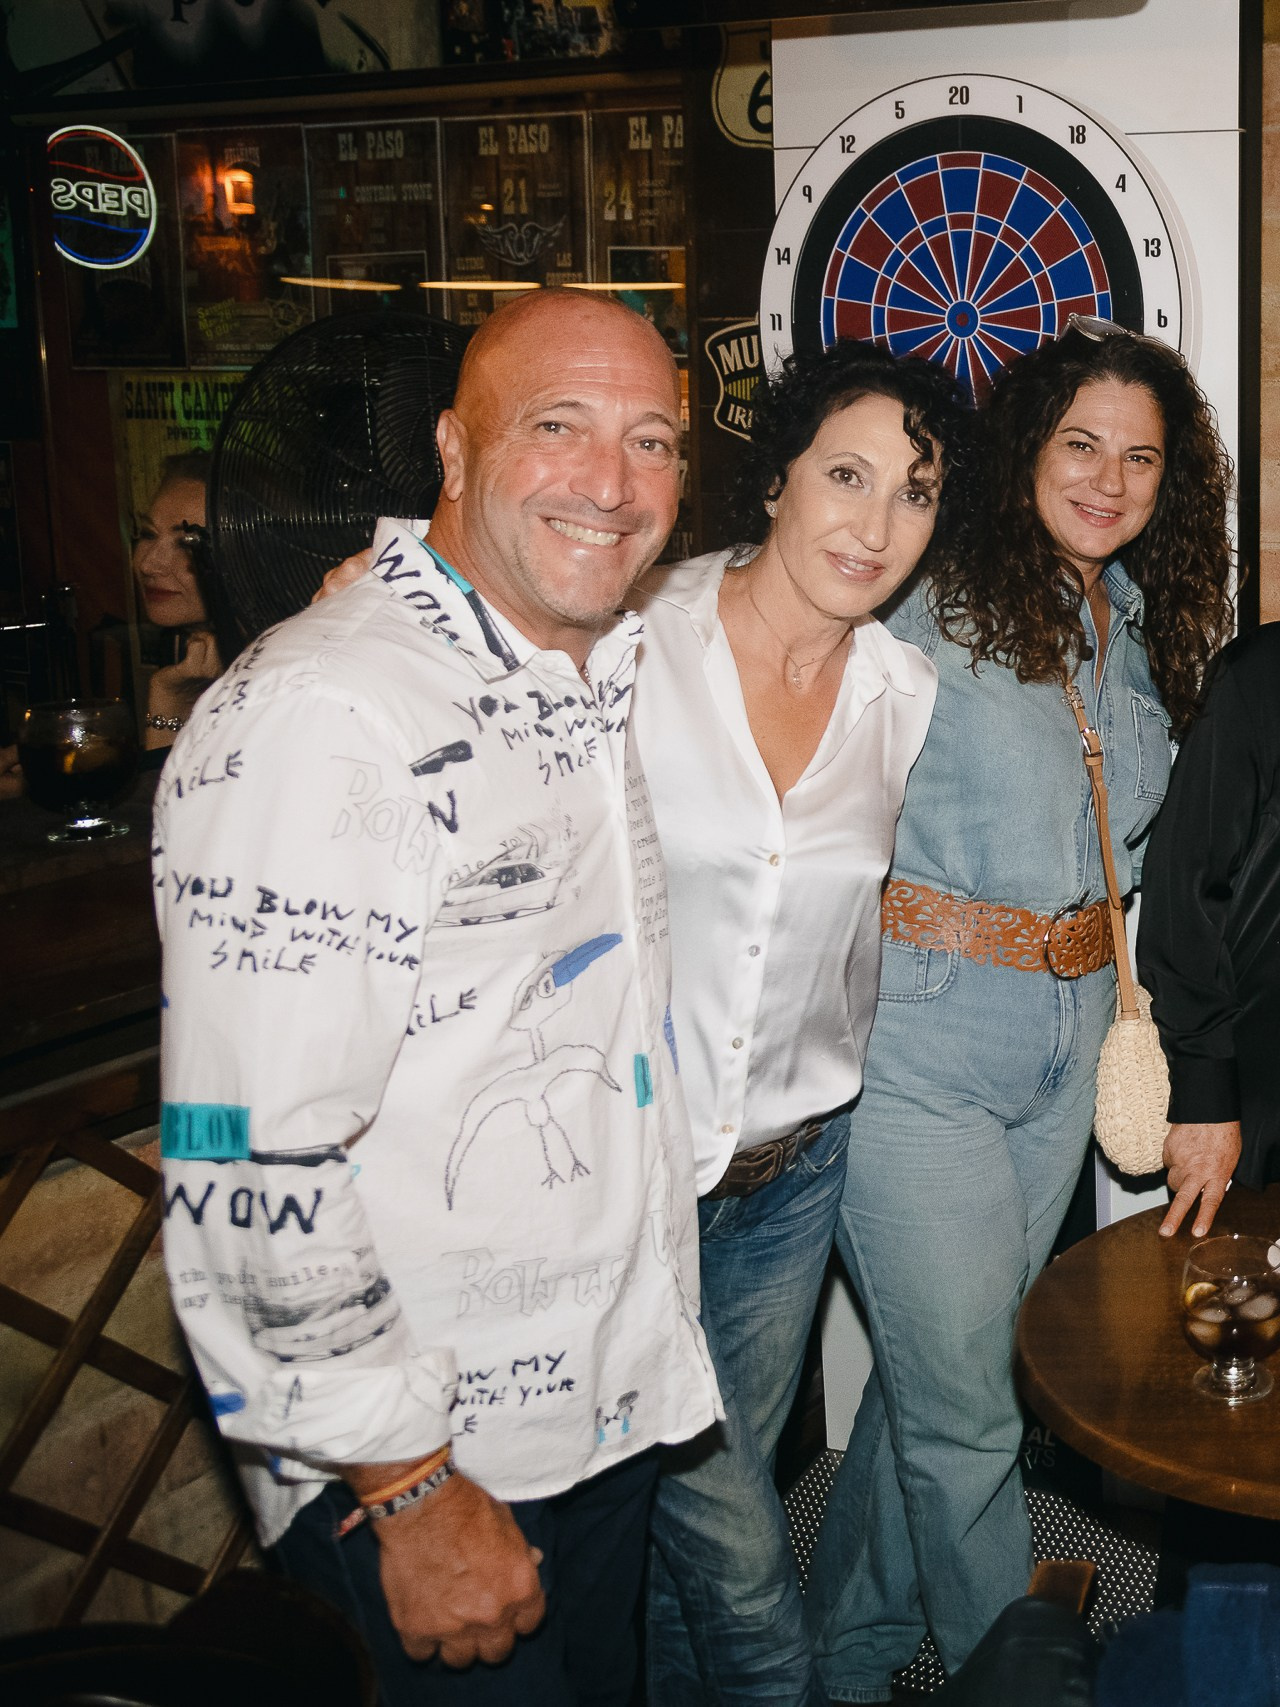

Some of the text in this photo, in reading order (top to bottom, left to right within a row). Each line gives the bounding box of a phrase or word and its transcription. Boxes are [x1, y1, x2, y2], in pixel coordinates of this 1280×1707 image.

[949, 86, 969, 105] 20
[1016, 95, 1023, 113] 1
[895, 101, 905, 119] 5
[338, 129, 404, 161] EL PASO
[478, 123, 550, 156] EL PASO
[628, 116, 652, 150] EL
[839, 136, 856, 153] 12
[1068, 125, 1086, 144] 18
[1116, 174, 1126, 192] 4
[503, 177, 528, 215] 21
[603, 178, 635, 221] 24
[775, 248, 790, 264] 14
[1143, 239, 1161, 257] 13
[770, 313, 782, 330] 11
[125, 381, 176, 419] SANTI
[172, 869, 419, 943] YOU BLOW MY
[161, 1171, 324, 1235] WOW
[510, 1349, 567, 1378] MY
